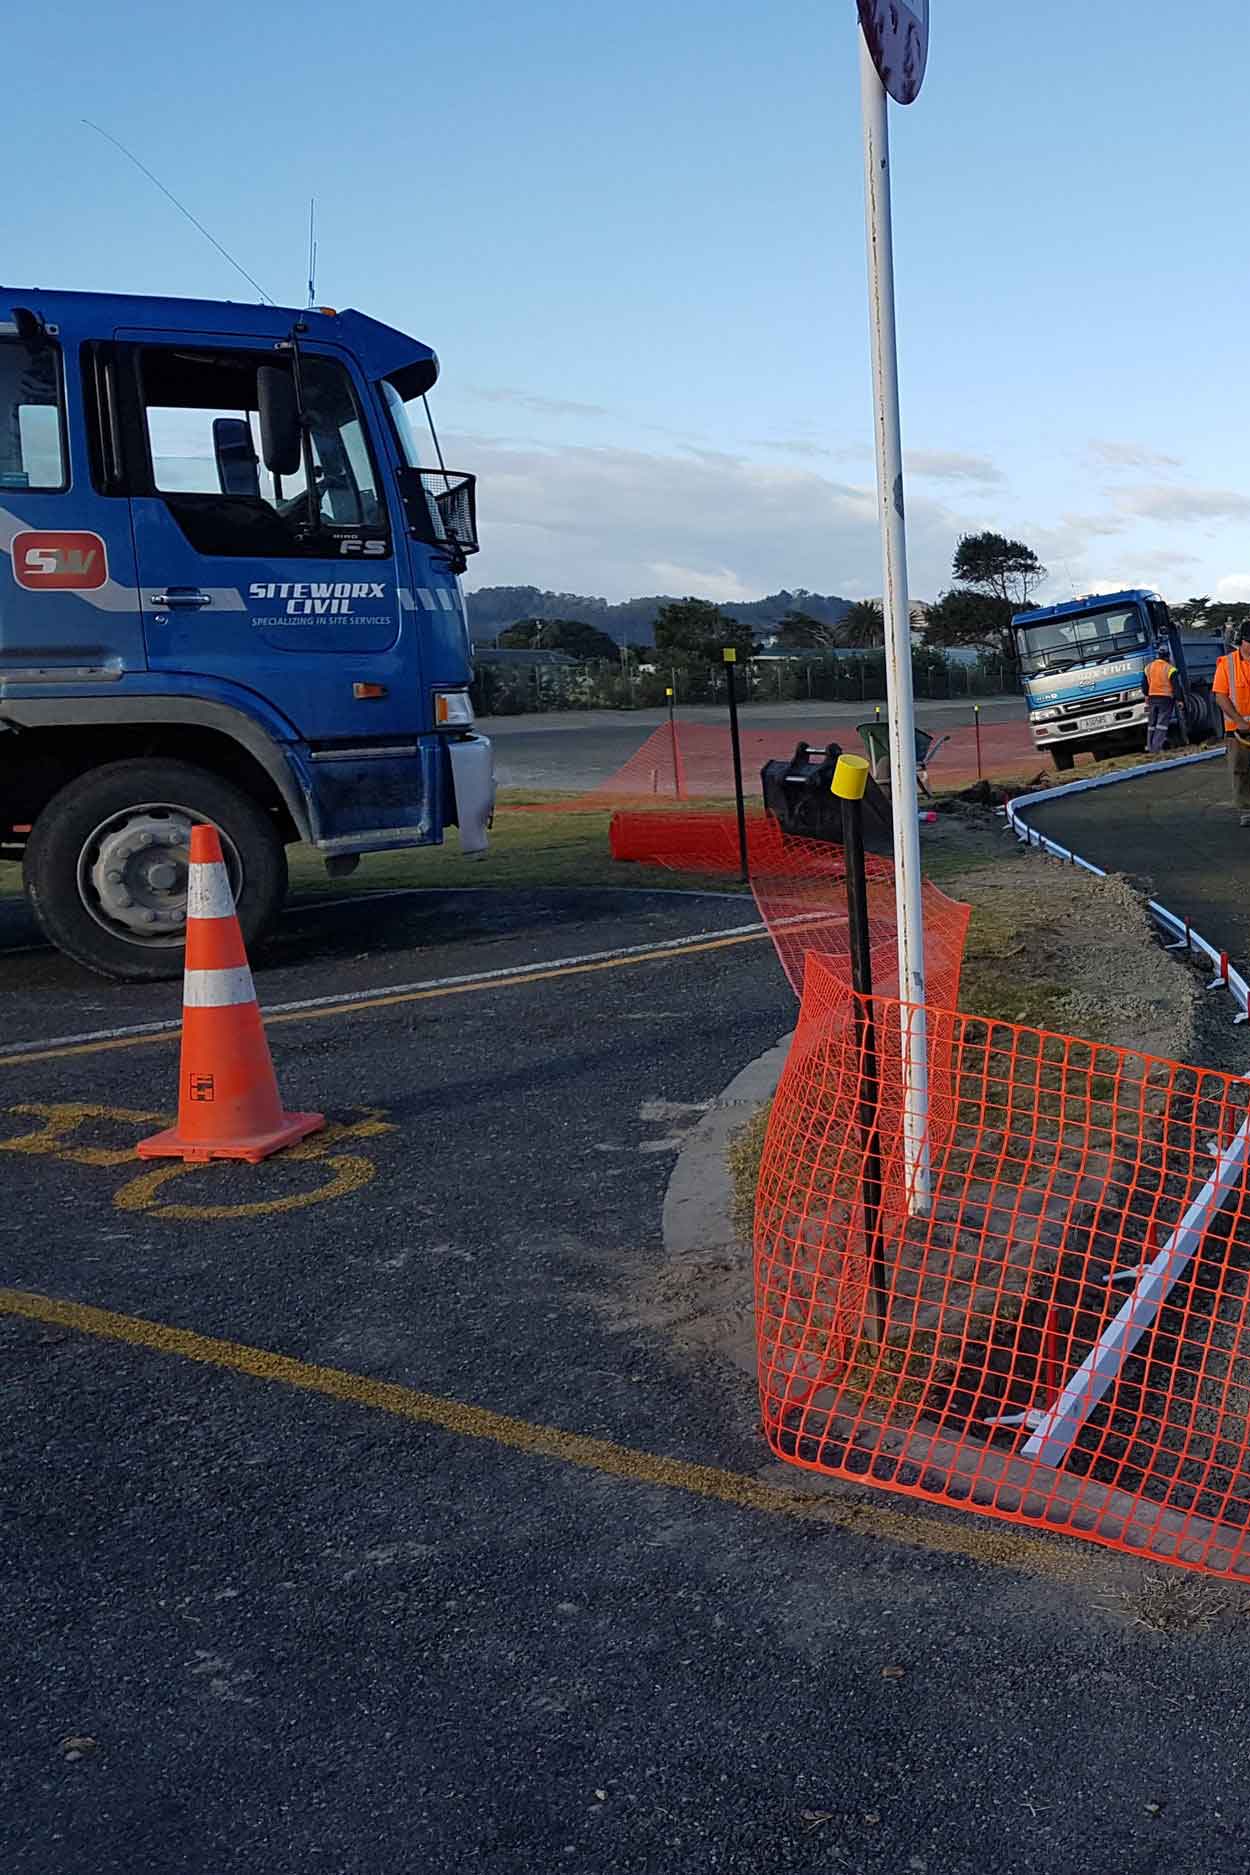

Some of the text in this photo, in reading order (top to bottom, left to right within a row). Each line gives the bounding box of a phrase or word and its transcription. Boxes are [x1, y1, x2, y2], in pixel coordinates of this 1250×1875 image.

[340, 540, 386, 554] FS
[24, 548, 96, 574] SW
[248, 583, 386, 598] SITEWORX
[286, 599, 356, 614] CIVIL
[252, 616, 391, 626] SPECIALIZING IN SITE SERVICES
